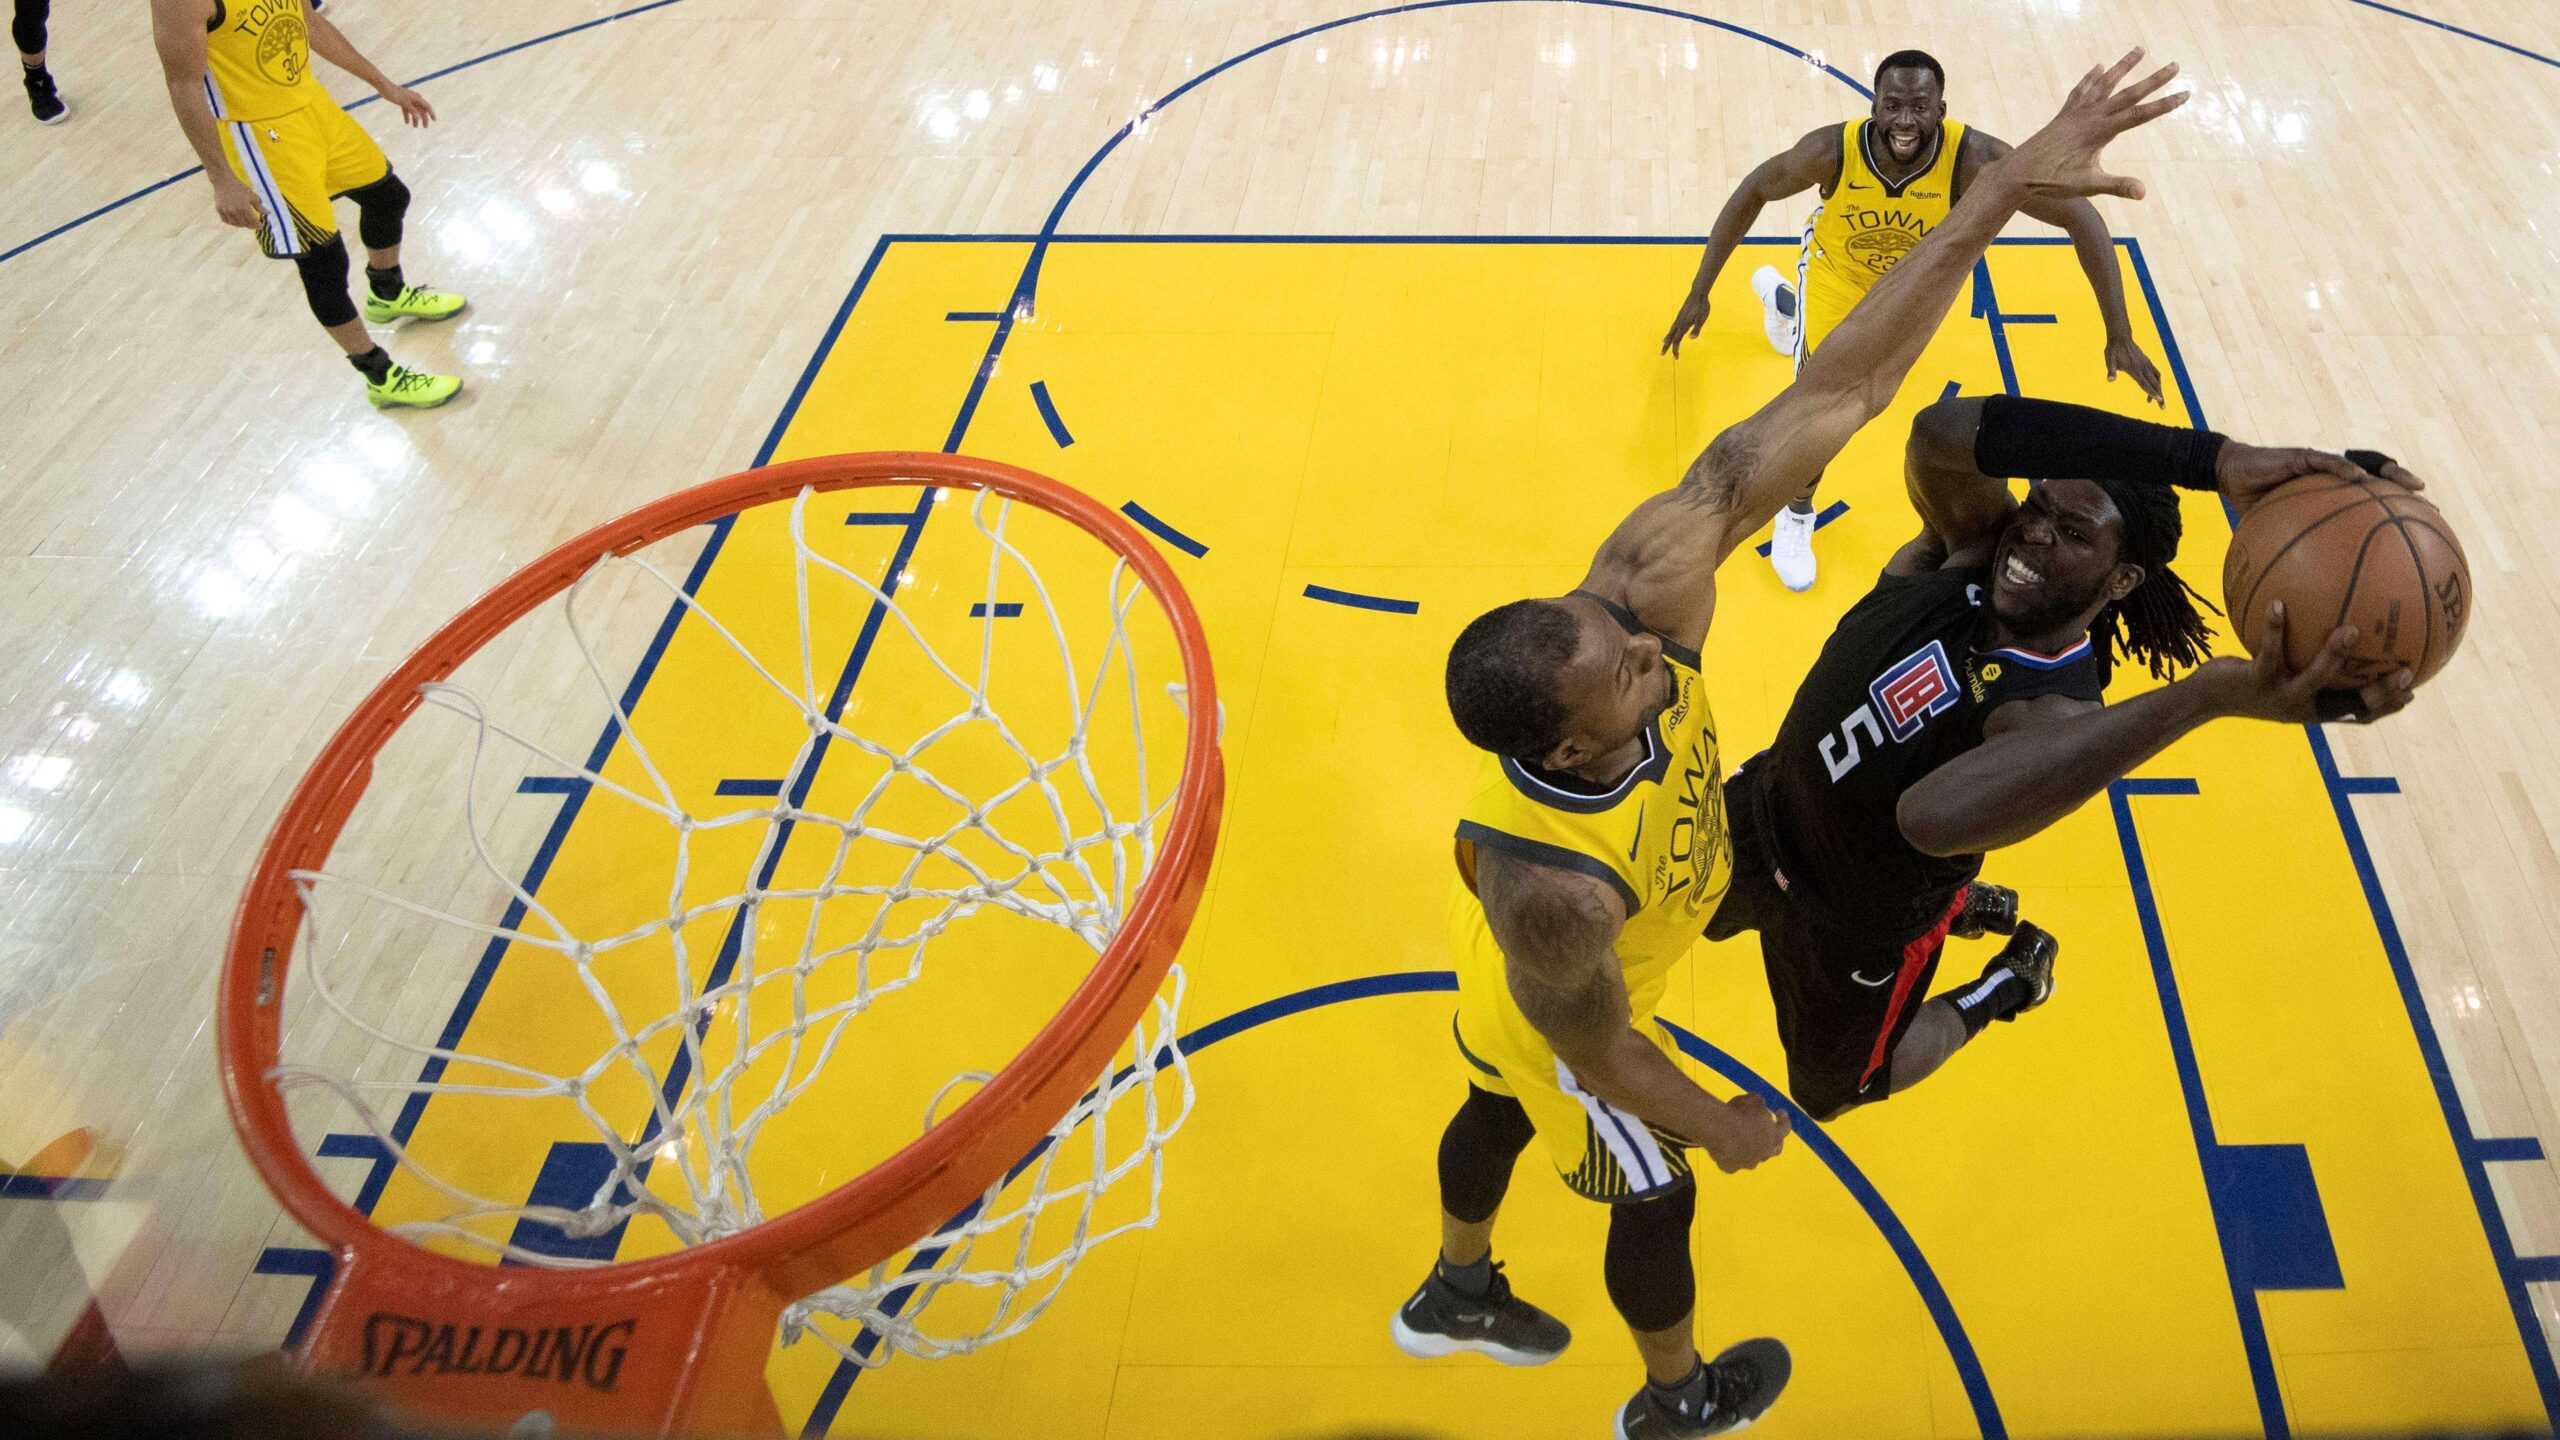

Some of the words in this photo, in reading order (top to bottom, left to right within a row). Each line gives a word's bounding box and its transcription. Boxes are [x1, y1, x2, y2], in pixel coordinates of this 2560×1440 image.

[283, 52, 299, 81] 30
[1846, 203, 1860, 213] The
[1909, 190, 1942, 199] Rakuten
[1840, 209, 1935, 237] TOWN
[1867, 253, 1899, 271] 23
[1965, 657, 1986, 704] bumble
[1818, 703, 1884, 784] 5
[1659, 712, 1717, 906] TOWN
[1655, 855, 1669, 890] The
[360, 1311, 638, 1392] SPALDING
